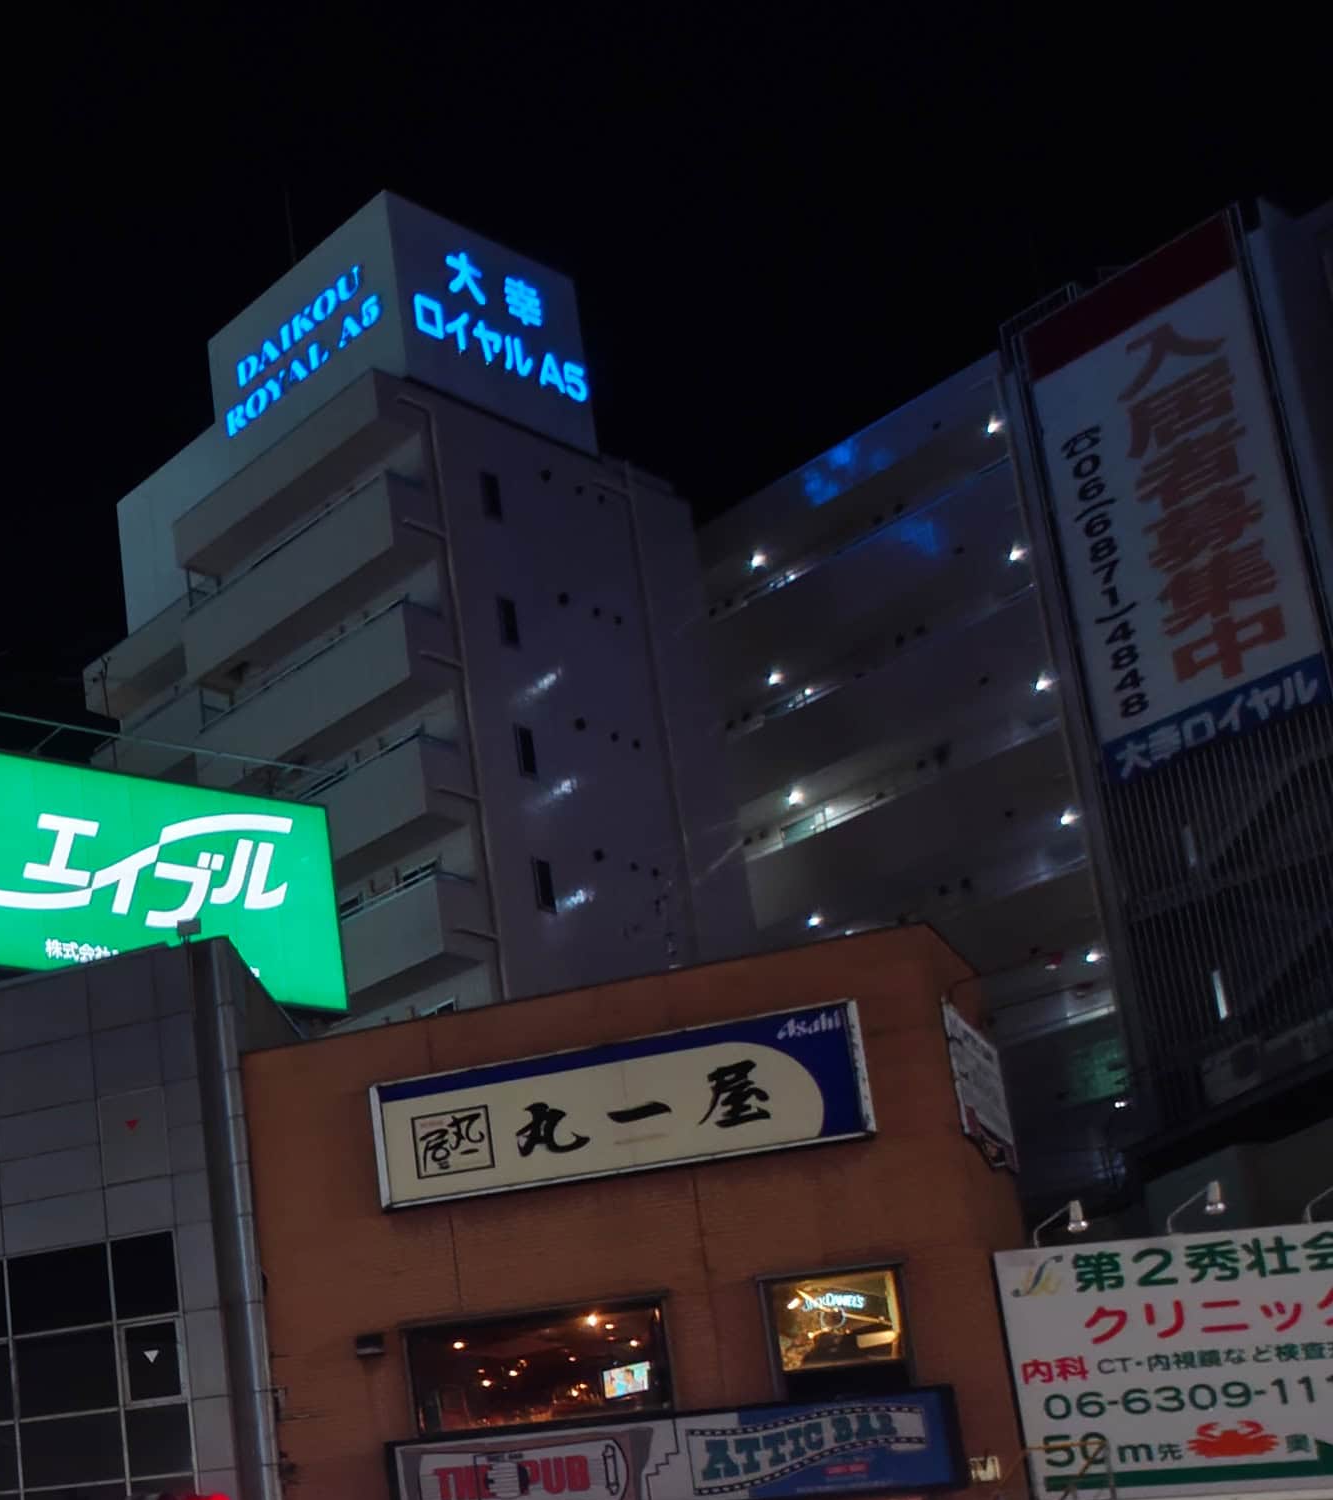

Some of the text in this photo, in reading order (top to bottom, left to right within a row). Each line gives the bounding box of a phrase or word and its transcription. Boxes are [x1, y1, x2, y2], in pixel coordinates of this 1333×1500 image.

[225, 294, 382, 438] ROYAL A5
[236, 264, 363, 389] DAIKOU
[1117, 322, 1286, 684] 入居者募集中
[777, 1011, 843, 1041] Asahi
[516, 1059, 773, 1158] 丸一屋
[1021, 1342, 1333, 1385] 内科 CT・内視鏡など検査
[525, 1454, 591, 1496] PUB
[701, 1412, 898, 1482] ATTIC BAR
